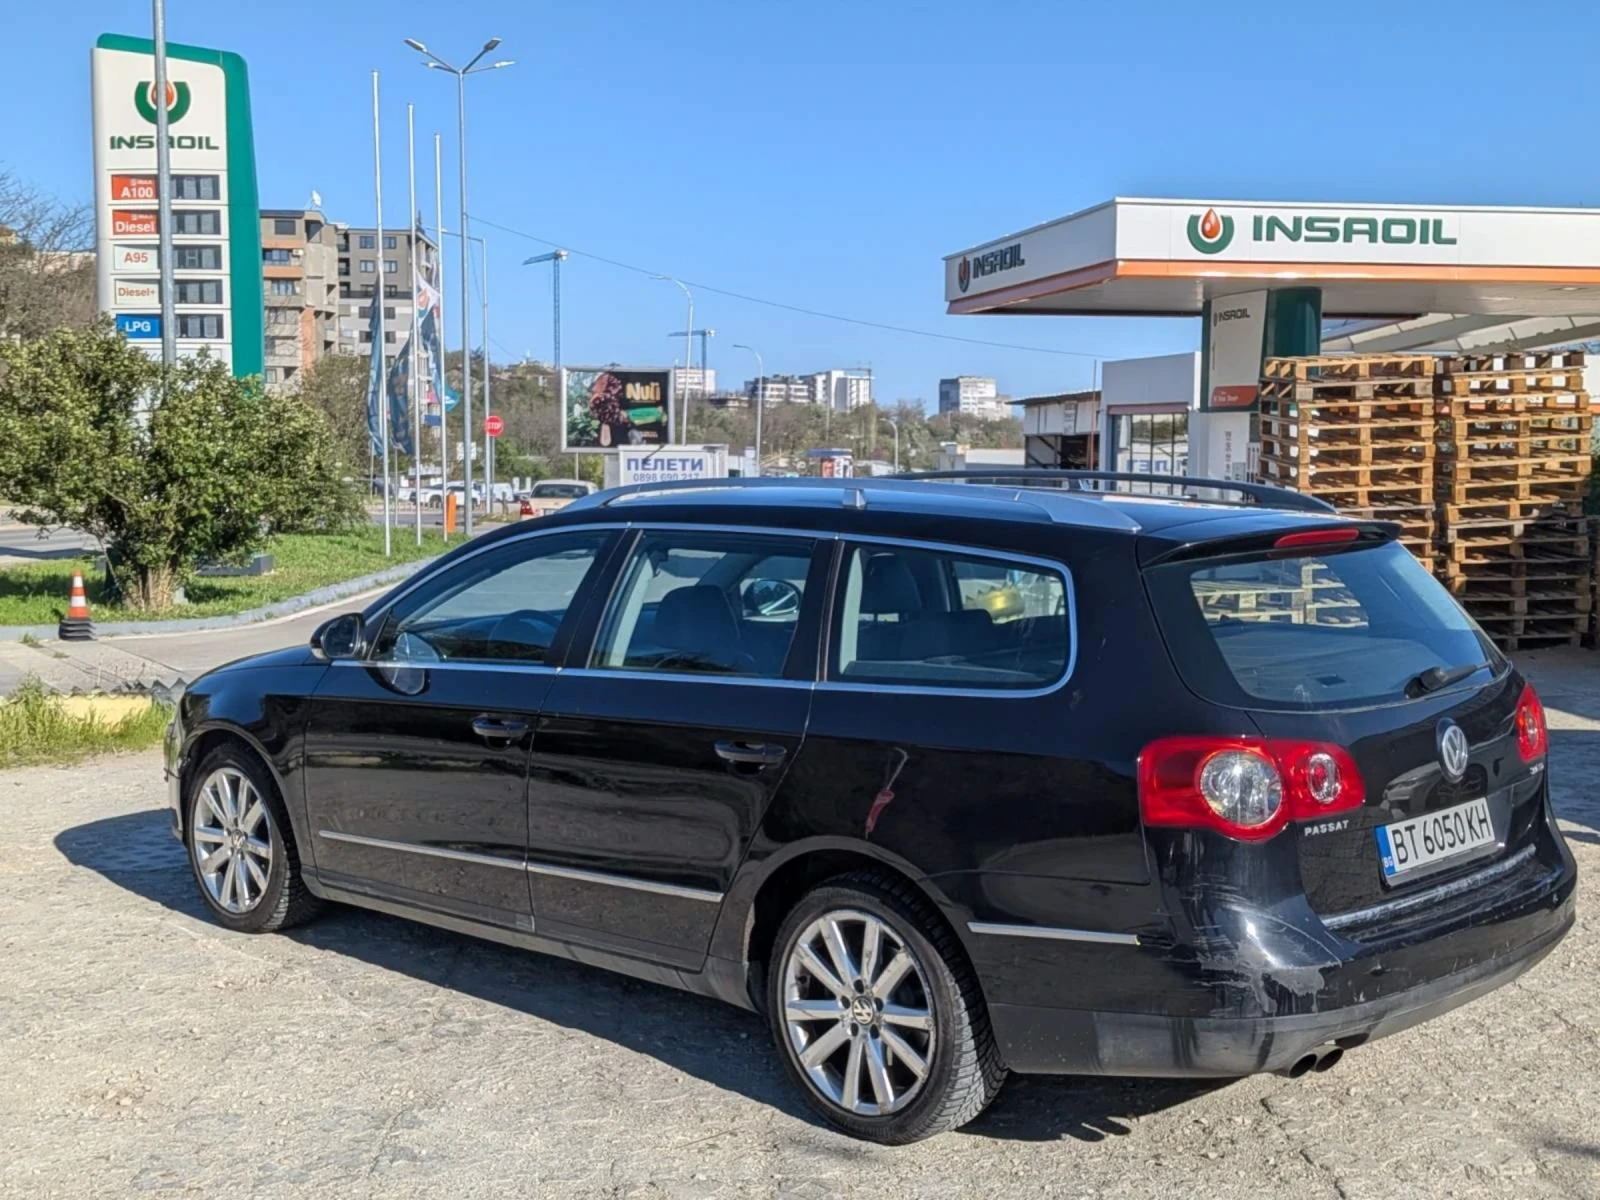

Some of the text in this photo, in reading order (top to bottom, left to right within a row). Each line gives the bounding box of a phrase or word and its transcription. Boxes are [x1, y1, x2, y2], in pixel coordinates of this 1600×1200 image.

[121, 187, 153, 198] A100
[115, 221, 155, 233] Diesel
[1252, 215, 1457, 245] INSAOIL
[124, 252, 148, 263] A95
[973, 243, 1025, 279] INSAOIL
[118, 287, 156, 297] Diesel+
[125, 321, 151, 332] LPG
[486, 421, 502, 430] STOP
[627, 458, 703, 471] ПЕЛЕТИ
[1304, 820, 1349, 836] PASSAT
[1391, 803, 1492, 865] BT 6050 KH
